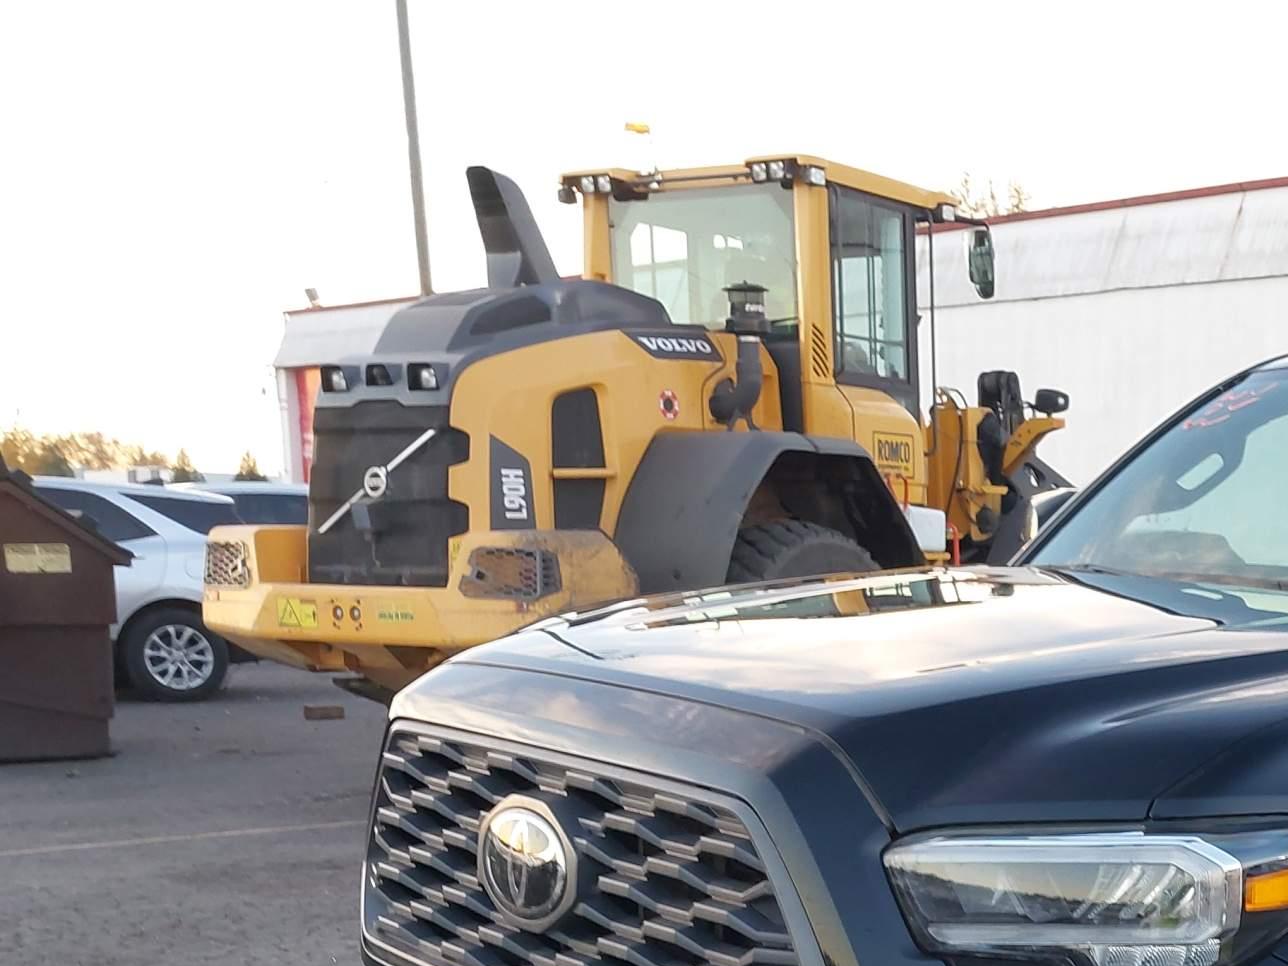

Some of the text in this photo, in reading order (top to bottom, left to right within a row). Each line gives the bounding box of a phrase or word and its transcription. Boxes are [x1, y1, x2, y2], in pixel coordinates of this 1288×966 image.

[636, 335, 712, 354] VOLVO
[877, 439, 910, 463] ROMCO
[500, 467, 528, 520] L90H
